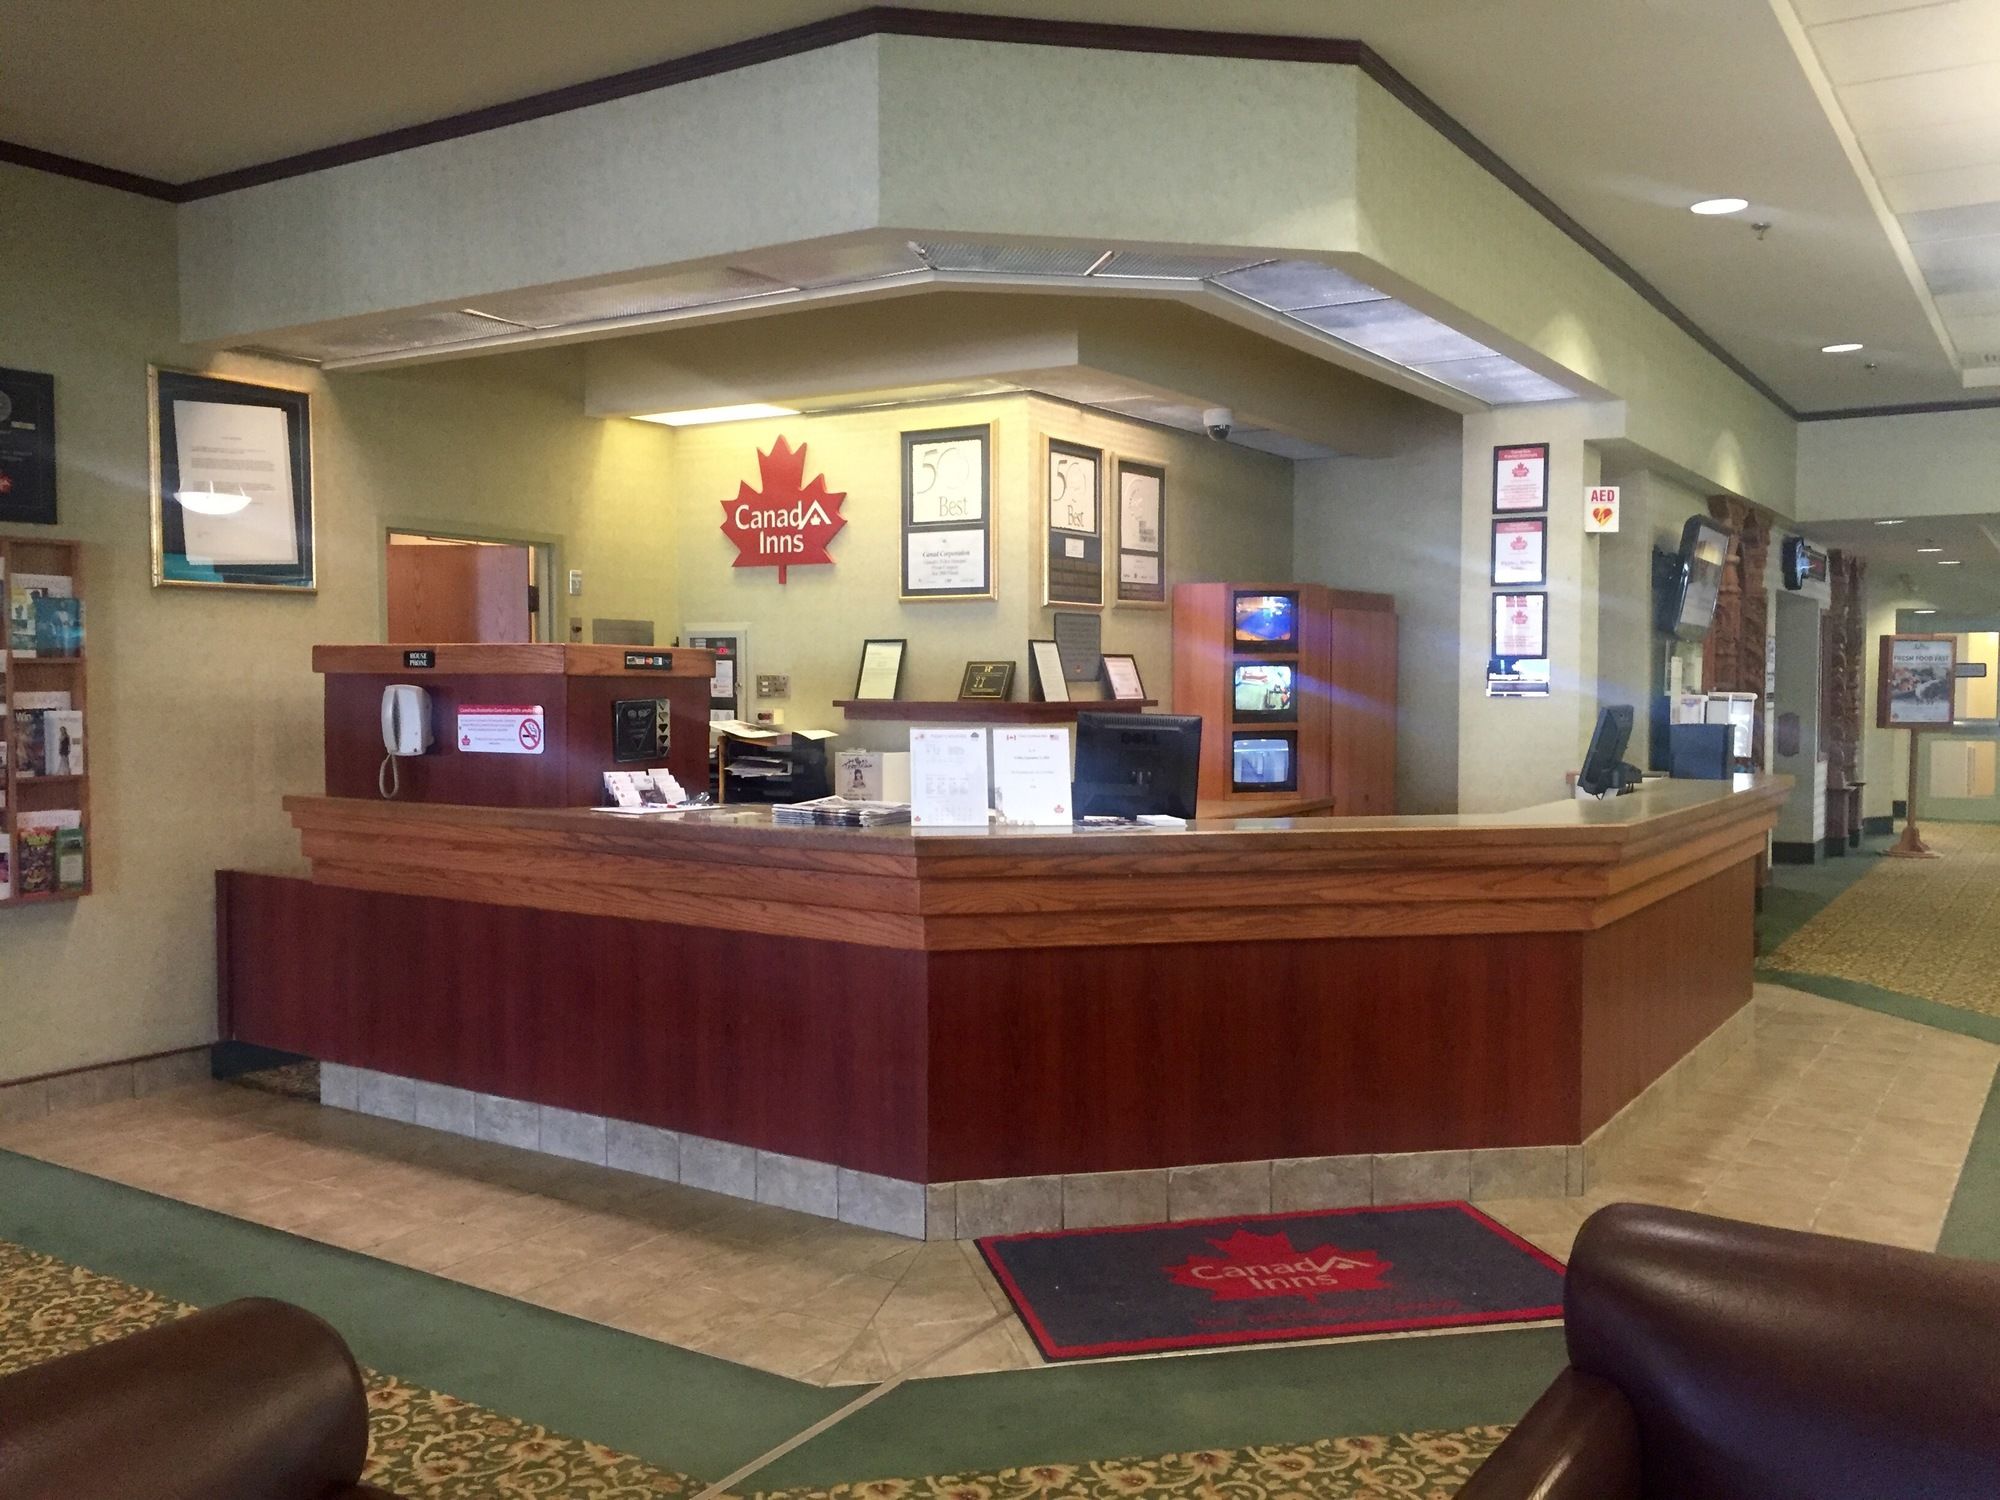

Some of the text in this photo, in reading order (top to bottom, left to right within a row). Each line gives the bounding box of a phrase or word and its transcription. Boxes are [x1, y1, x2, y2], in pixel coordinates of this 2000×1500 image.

[1591, 489, 1616, 503] AED
[939, 496, 969, 517] Best
[1067, 504, 1085, 528] Best
[759, 530, 805, 554] Inns
[409, 652, 427, 660] HOUSE
[409, 659, 428, 667] PHONE
[1246, 1272, 1338, 1290] Inns
